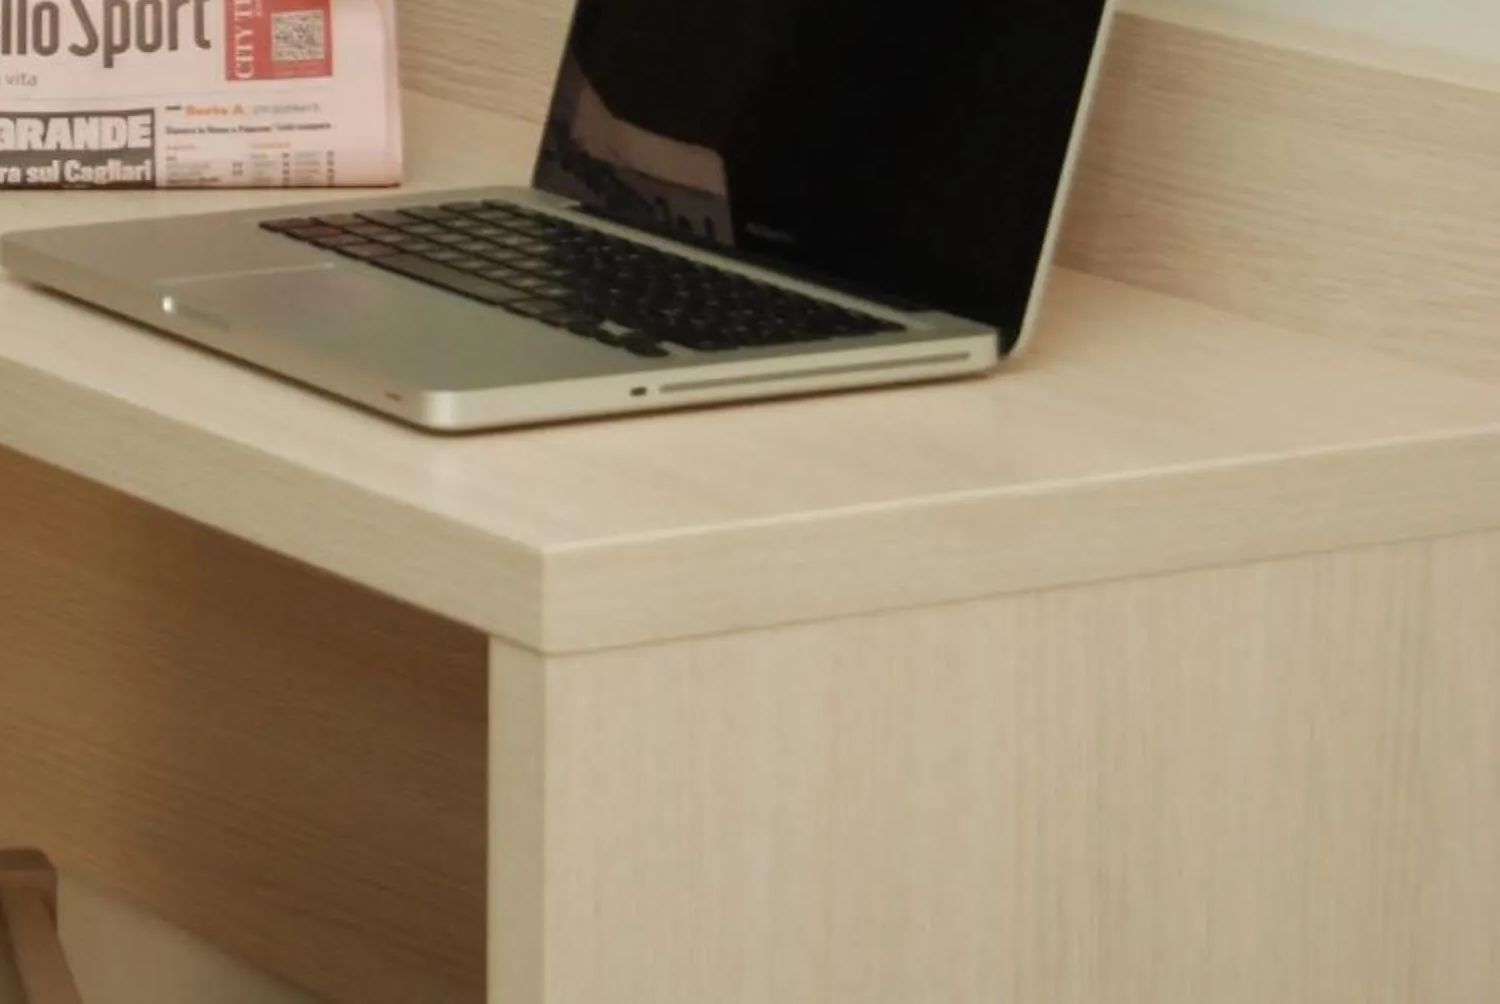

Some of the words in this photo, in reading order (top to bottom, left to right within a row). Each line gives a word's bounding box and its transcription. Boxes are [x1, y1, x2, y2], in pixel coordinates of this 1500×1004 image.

[234, 25, 255, 78] CITY
[5, 71, 38, 87] vita
[26, 160, 58, 183] sul
[63, 158, 152, 185] Cagliari
